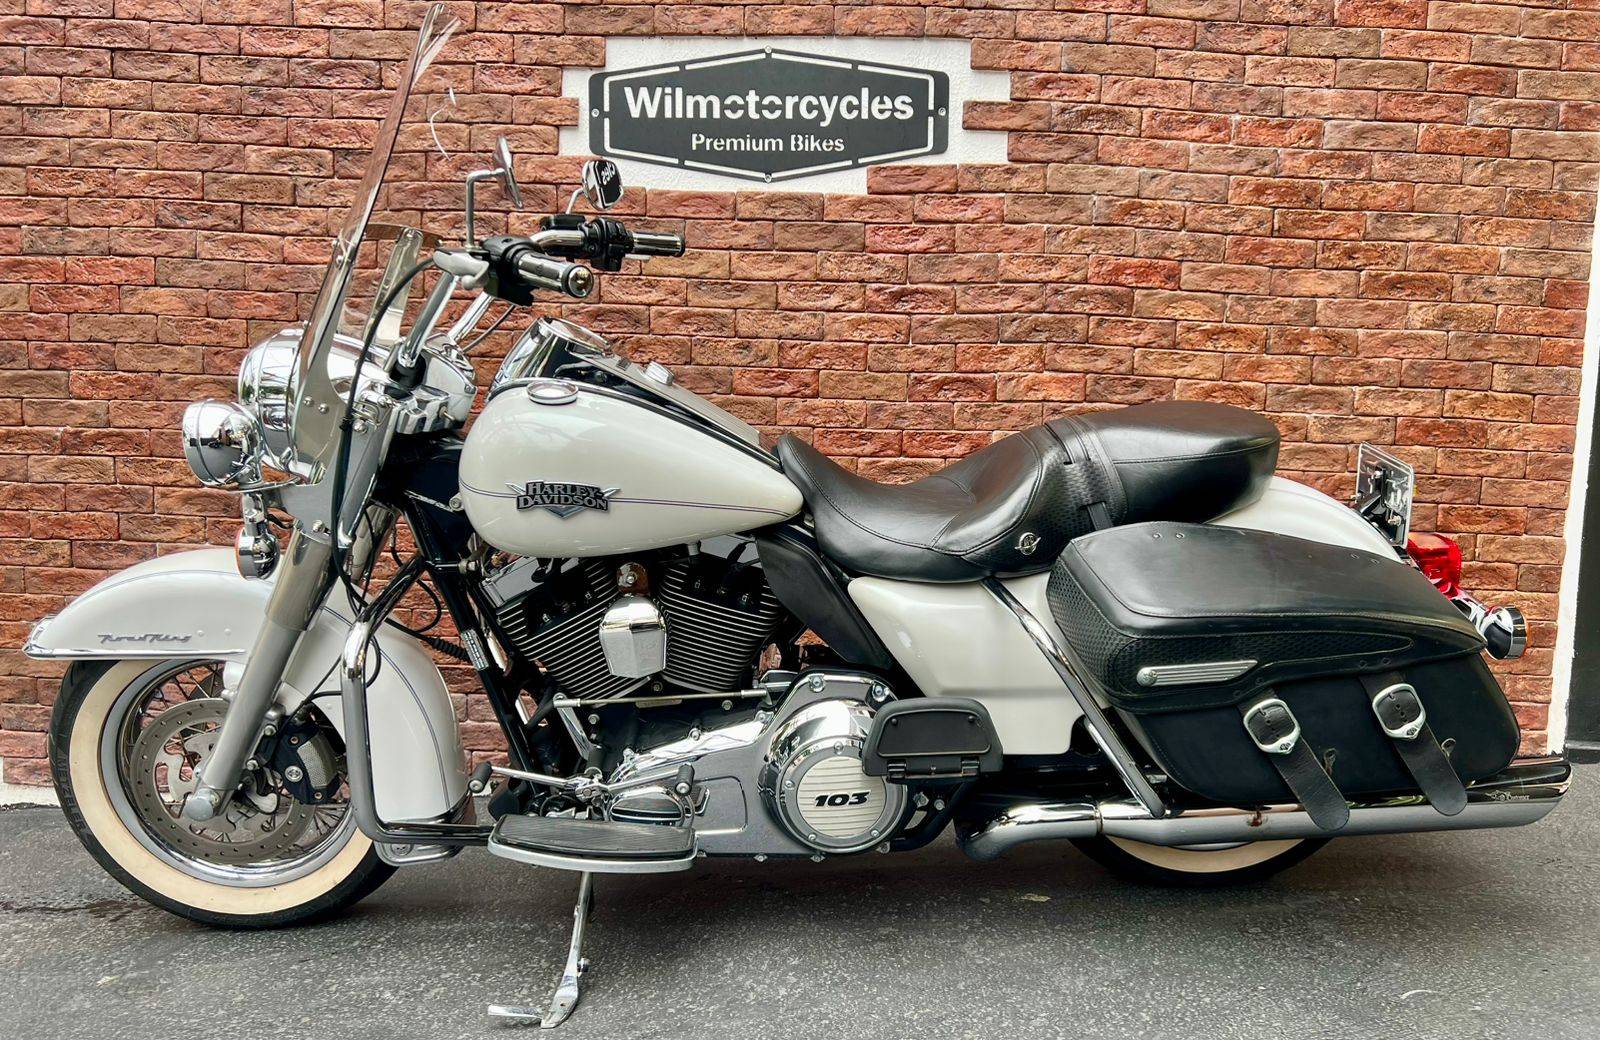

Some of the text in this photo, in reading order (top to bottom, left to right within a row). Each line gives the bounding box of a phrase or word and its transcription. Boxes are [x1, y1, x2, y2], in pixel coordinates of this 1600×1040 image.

[623, 86, 914, 128] Wilmotorcycles
[691, 133, 846, 152] Premium Bikes
[518, 494, 608, 511] DAVIDSON
[814, 791, 870, 807] 103
